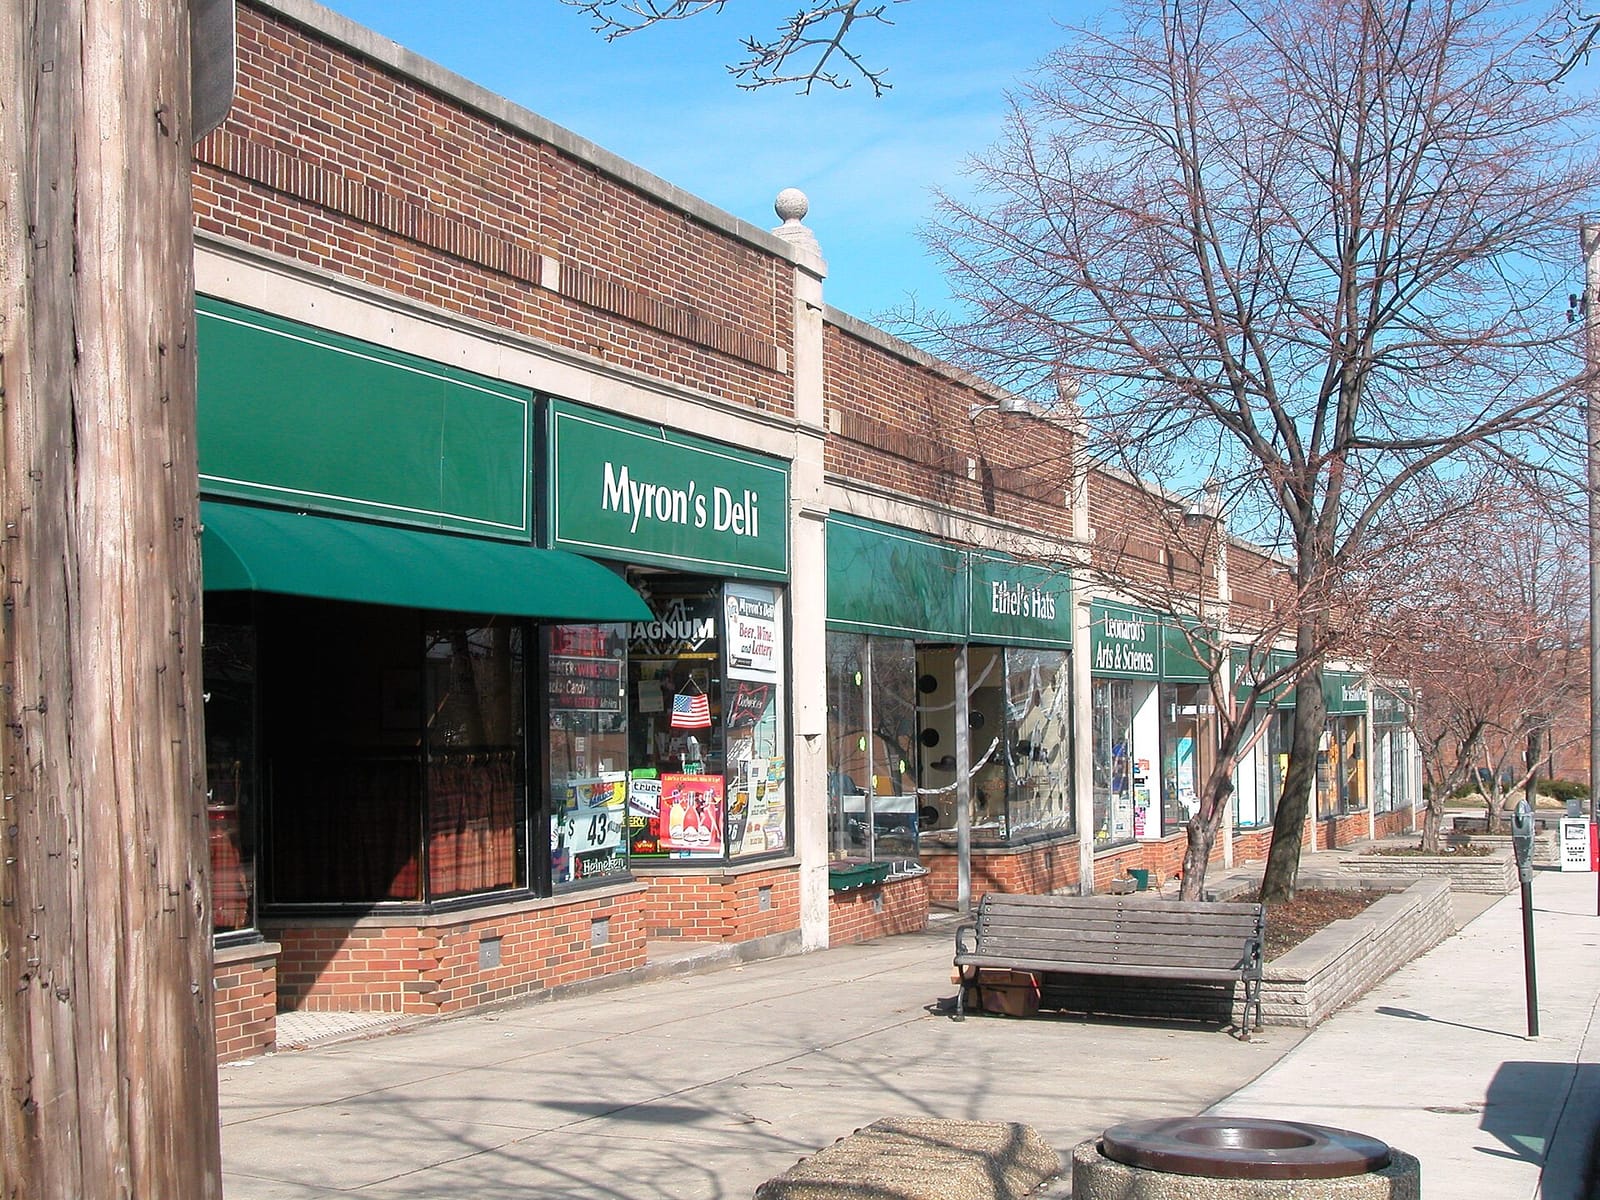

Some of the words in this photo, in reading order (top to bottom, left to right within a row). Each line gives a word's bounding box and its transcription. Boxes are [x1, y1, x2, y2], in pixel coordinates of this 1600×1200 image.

[601, 462, 707, 534] Myron's
[713, 486, 759, 537] Deli
[739, 598, 763, 617] Myron's
[991, 580, 1030, 617] Ethel's
[1031, 588, 1056, 620] Hats
[1104, 610, 1146, 642] Leonardo's
[740, 644, 752, 654] and
[751, 640, 774, 661] Lottery
[1096, 640, 1114, 669] Arts
[1114, 643, 1122, 670] &
[1122, 642, 1154, 672] Sciences
[587, 813, 608, 847] 43
[582, 856, 625, 876] Heineken
